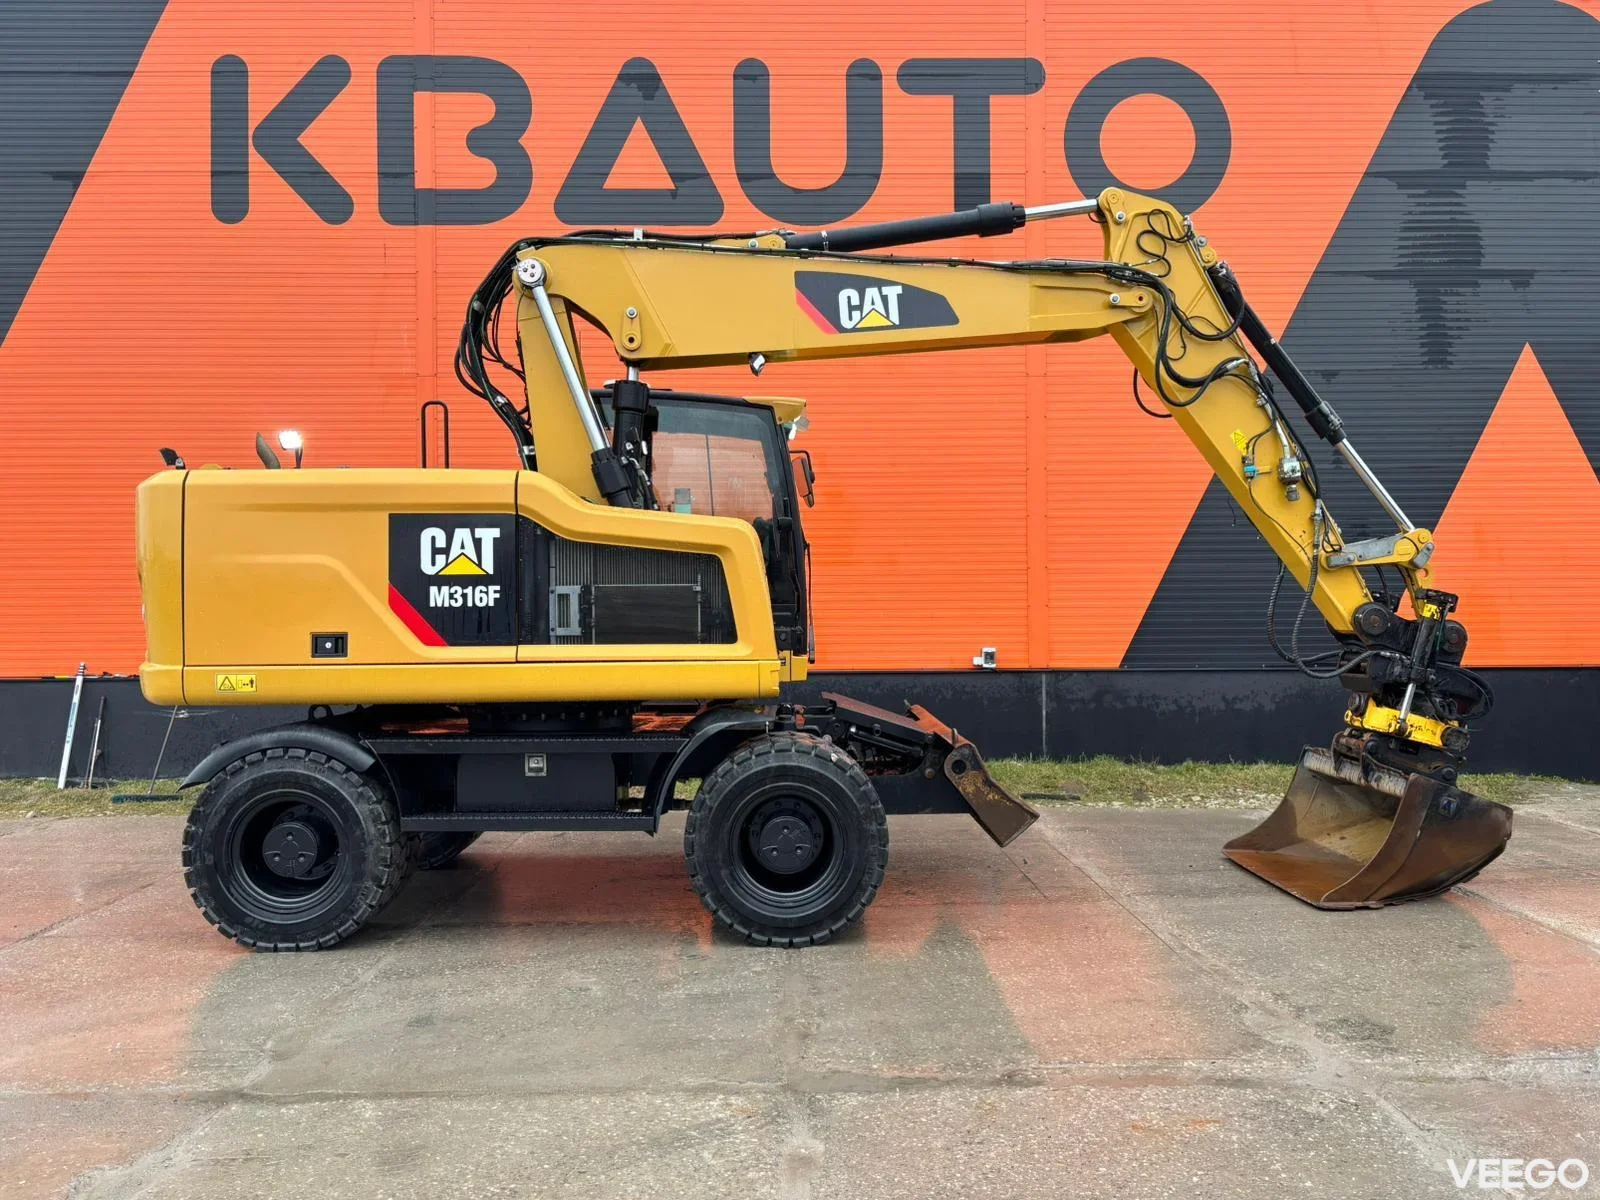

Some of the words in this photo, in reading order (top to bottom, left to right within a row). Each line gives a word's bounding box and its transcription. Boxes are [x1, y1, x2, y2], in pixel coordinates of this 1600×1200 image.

[838, 285, 903, 329] CAT
[420, 527, 501, 576] CAT
[429, 585, 501, 608] M316F
